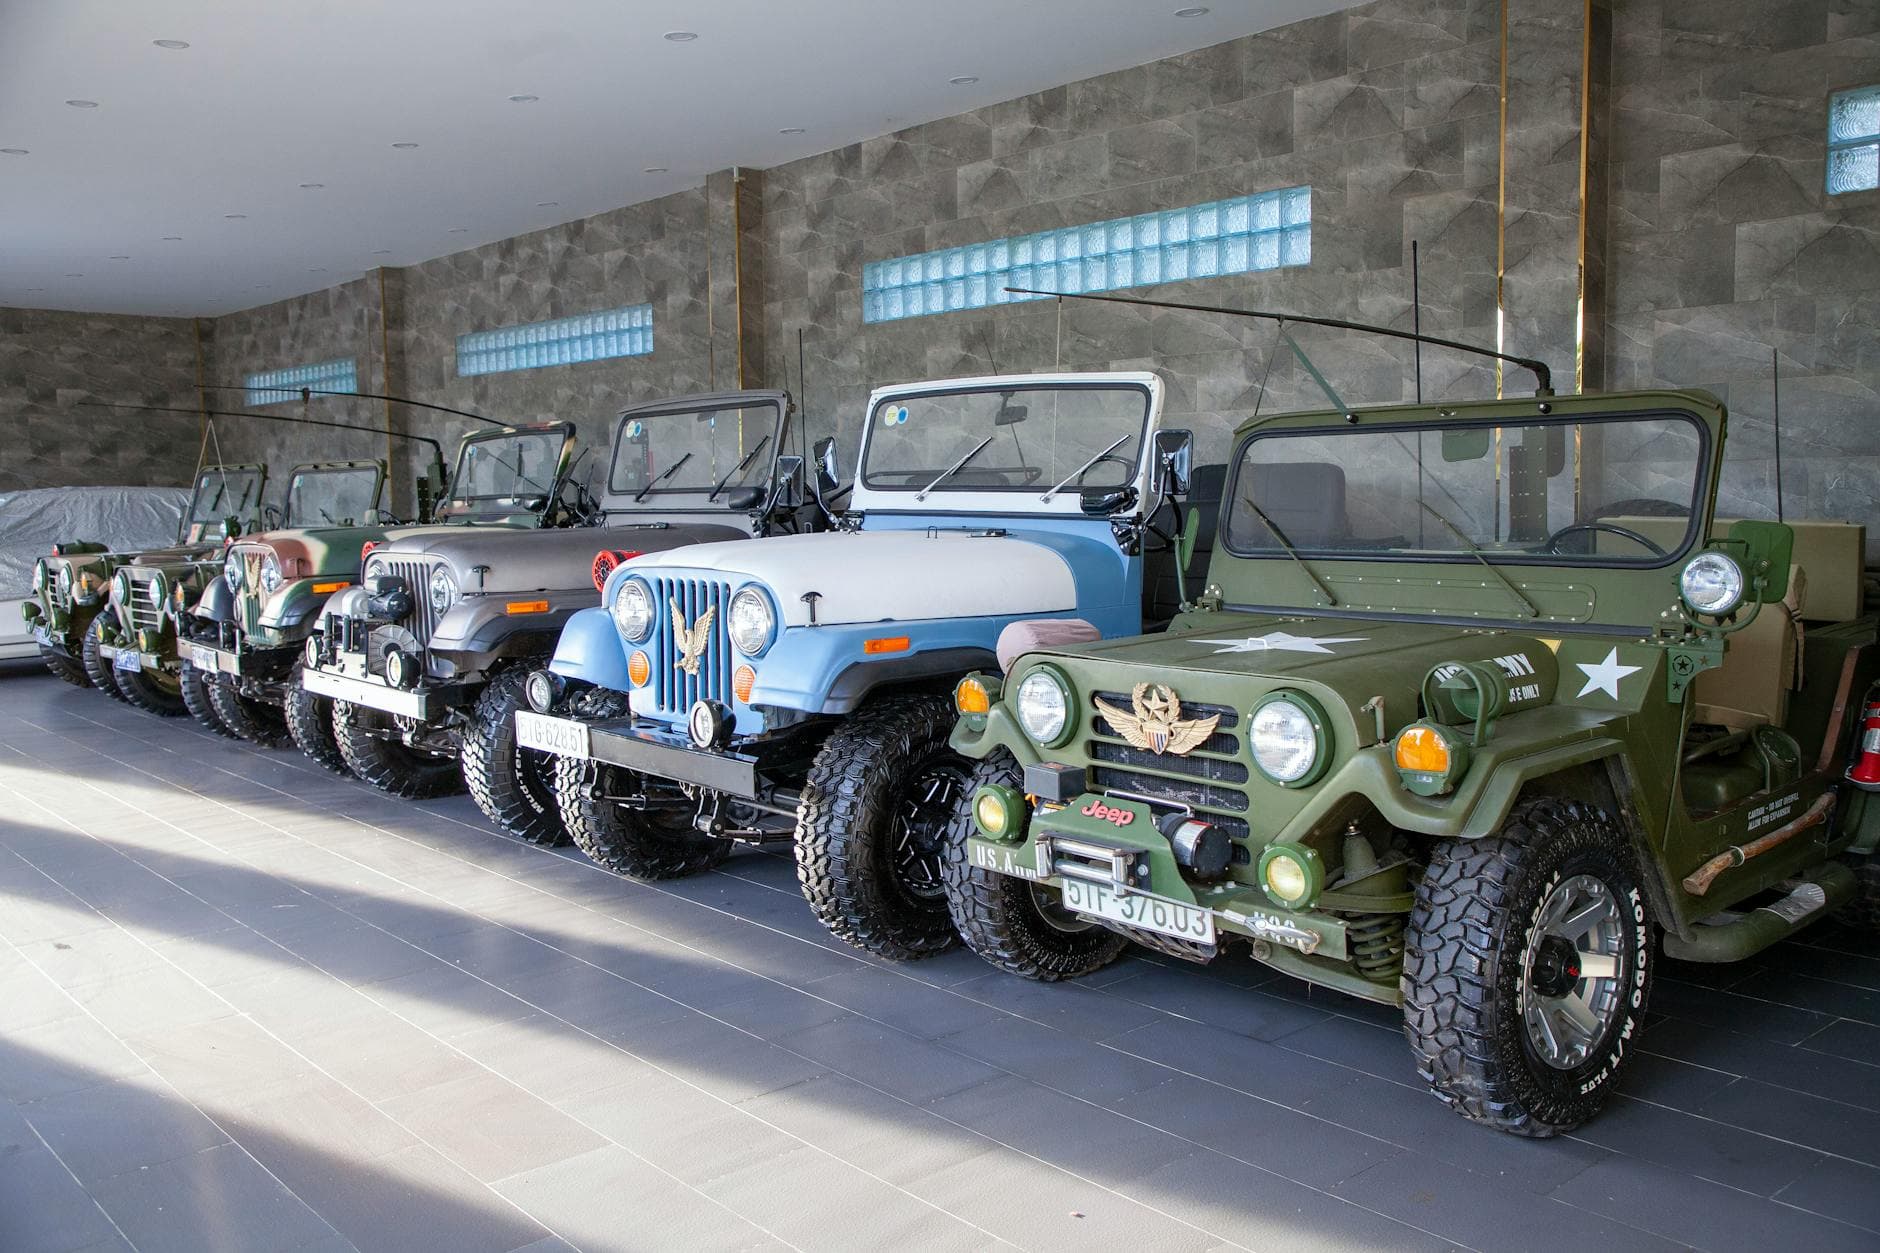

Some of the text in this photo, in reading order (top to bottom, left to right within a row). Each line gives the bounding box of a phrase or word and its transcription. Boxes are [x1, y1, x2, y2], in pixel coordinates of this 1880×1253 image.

[1081, 800, 1135, 826] Jeep
[1580, 887, 1647, 1095] KOMODO M/T PLUS
